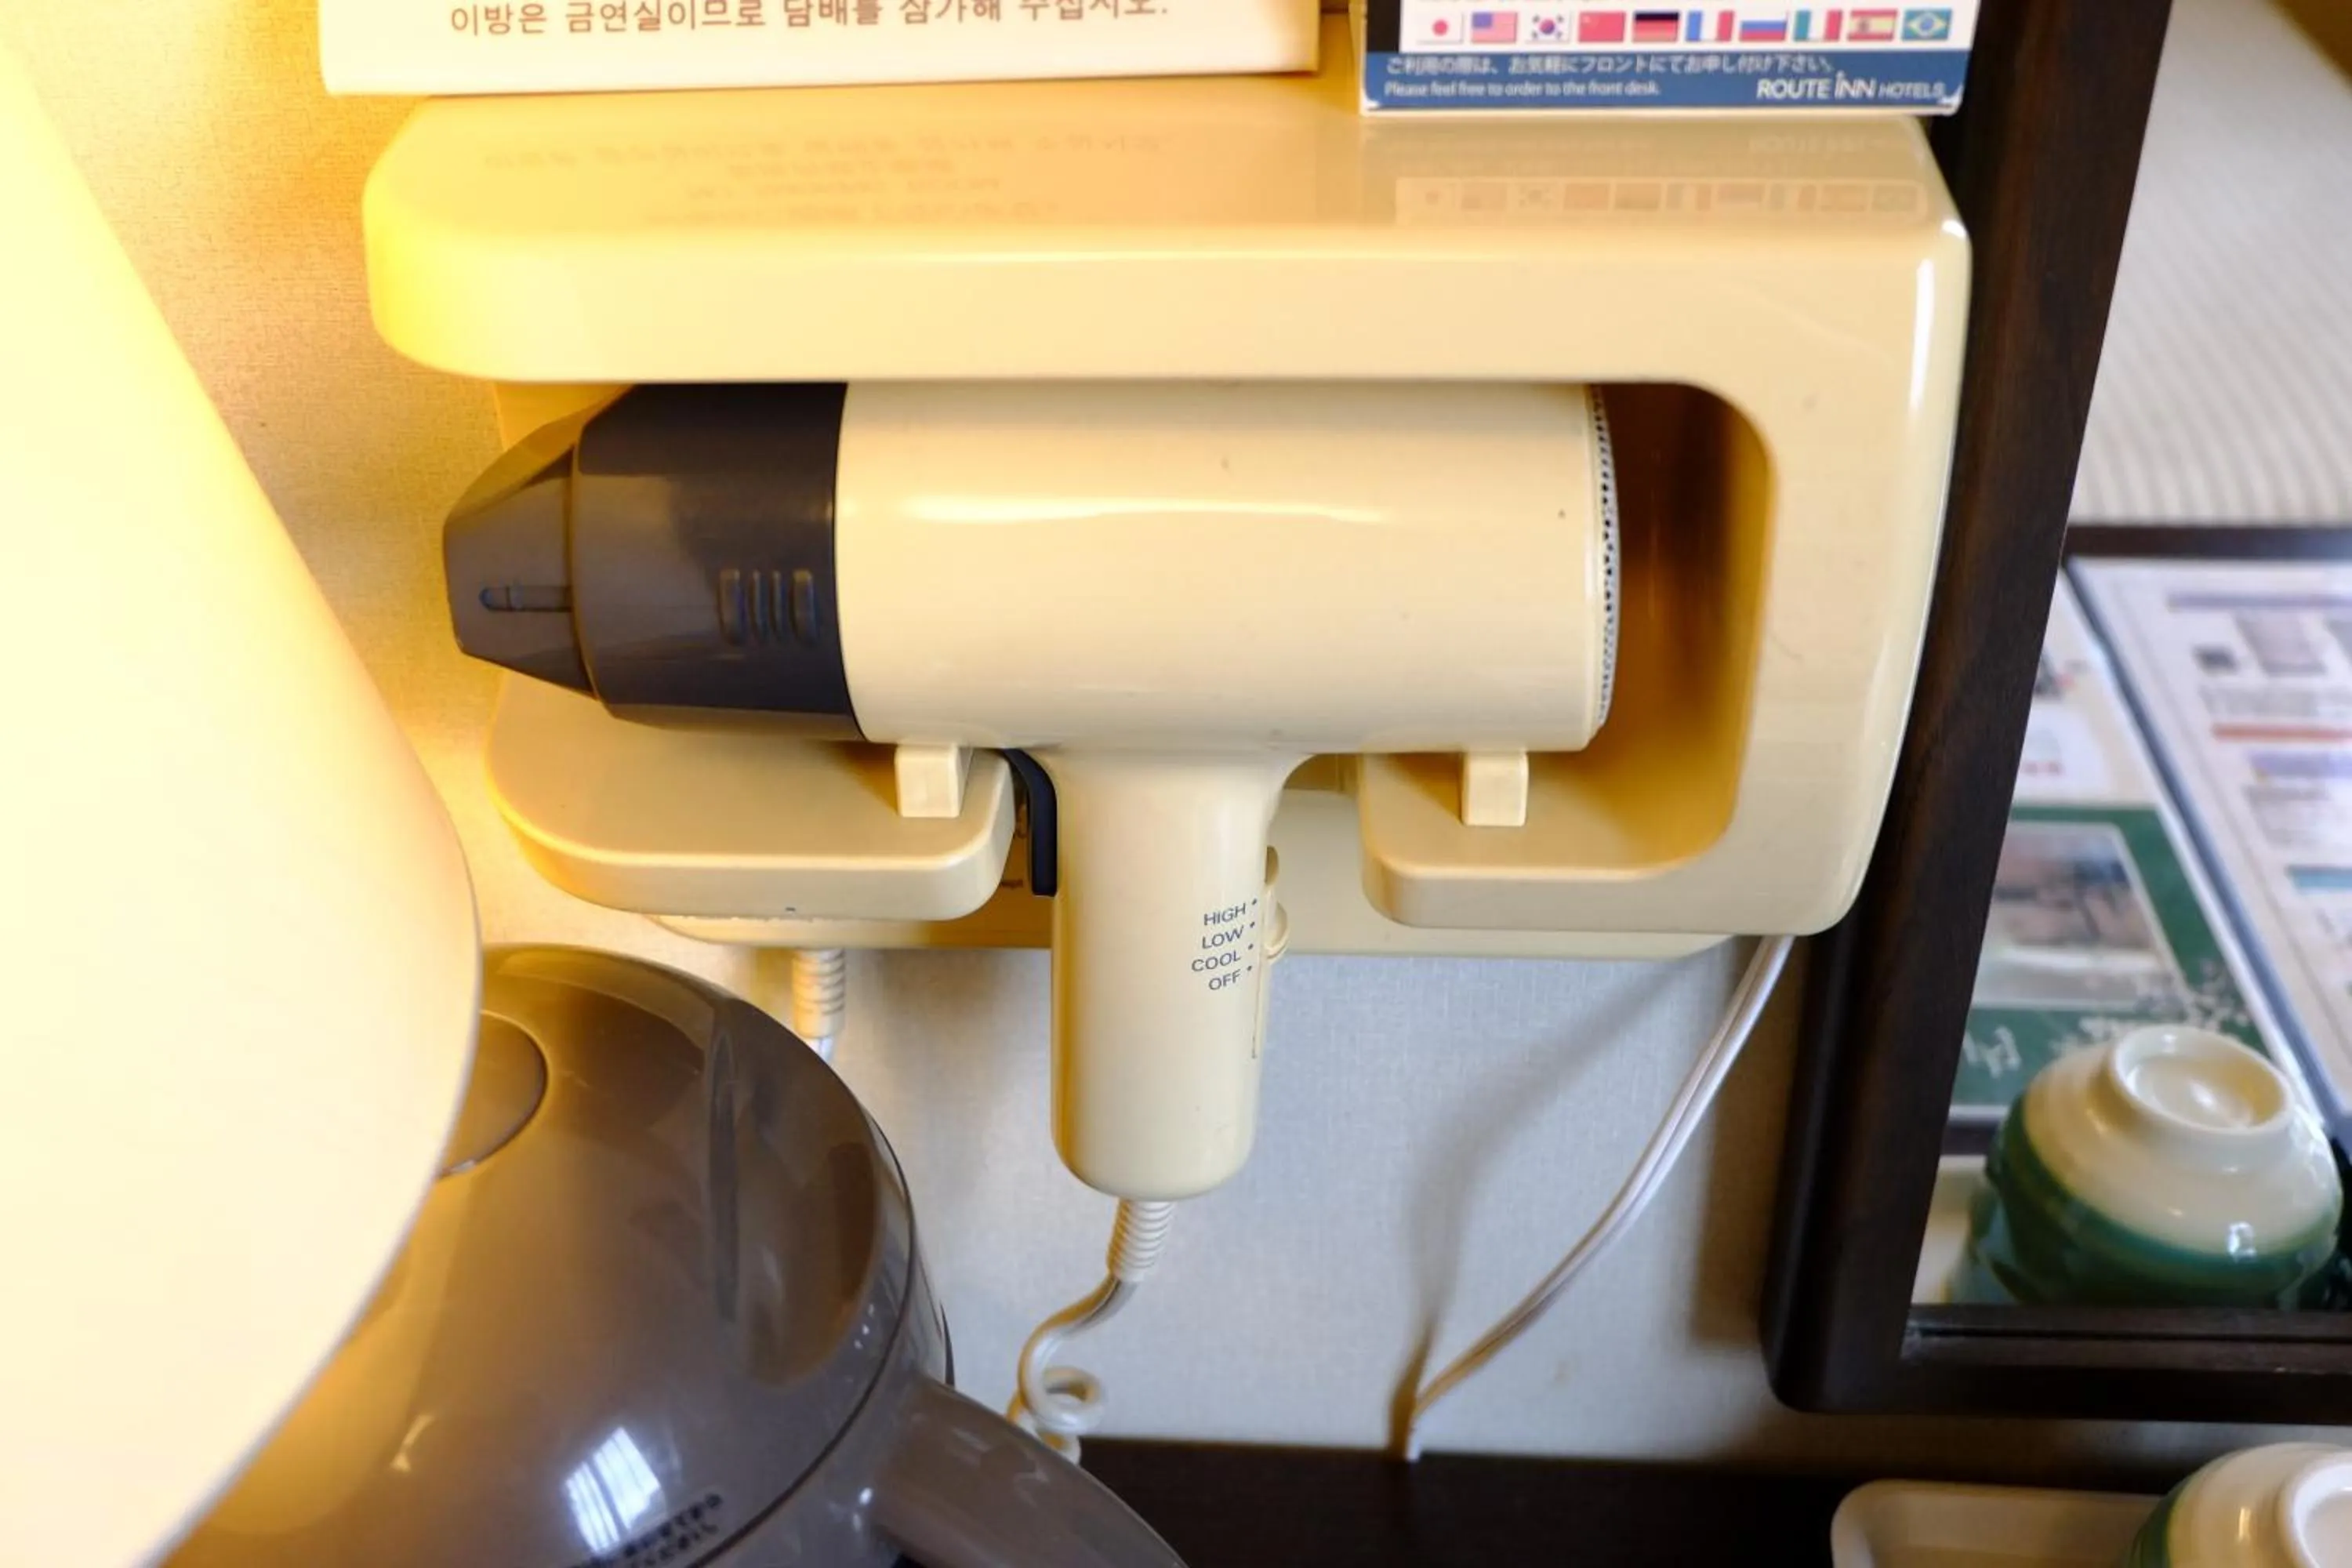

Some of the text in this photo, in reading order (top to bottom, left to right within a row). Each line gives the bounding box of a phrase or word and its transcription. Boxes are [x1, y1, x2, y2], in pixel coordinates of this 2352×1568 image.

[451, 2, 546, 36] 이방은
[565, 0, 766, 33] 금연실이므로
[1385, 80, 1428, 96] Please
[1430, 79, 1455, 96] feel
[1457, 79, 1487, 96] free
[1489, 81, 1504, 96] to
[1505, 79, 1543, 96] order
[1545, 81, 1562, 96] to
[1563, 79, 1587, 96] the
[1588, 79, 1623, 95] front
[1756, 78, 1831, 99] ROUTE
[1878, 82, 1946, 100] HOTELS
[1203, 902, 1247, 926] HIGH
[1202, 924, 1244, 949] LOW
[1191, 950, 1242, 972] COOL
[1208, 969, 1241, 990] OFF
